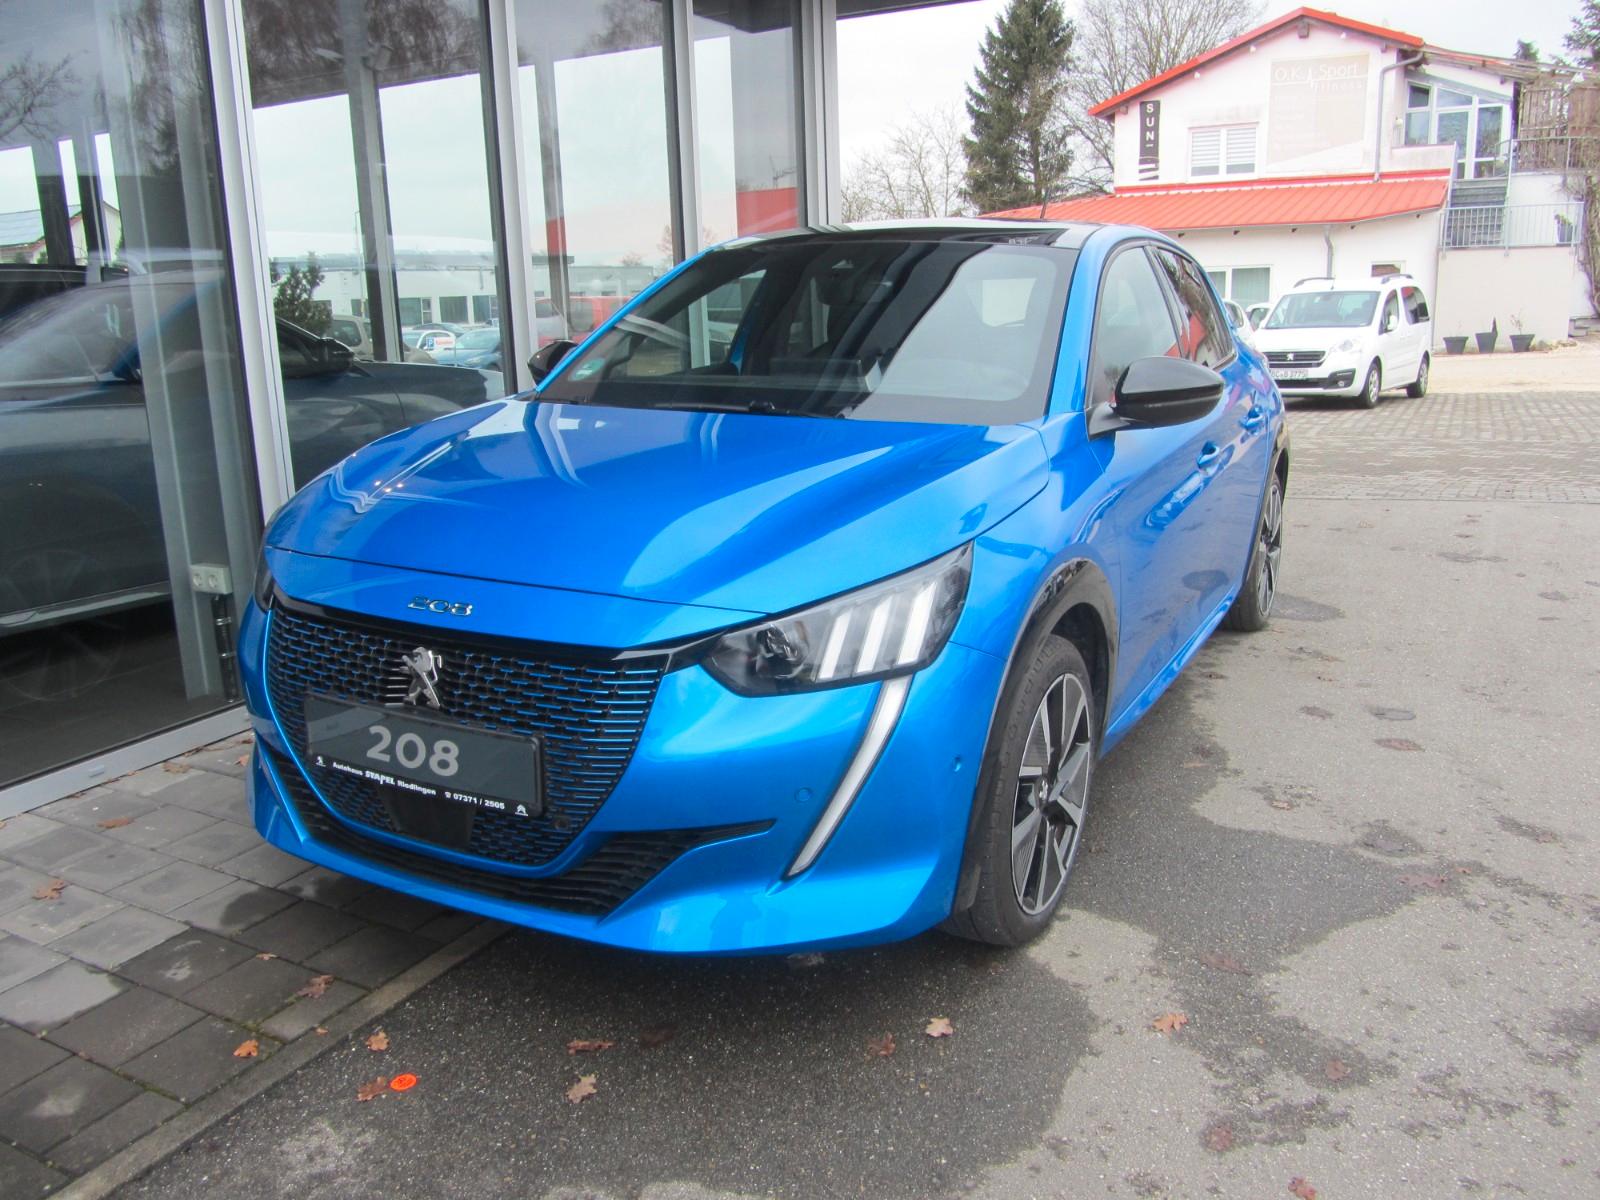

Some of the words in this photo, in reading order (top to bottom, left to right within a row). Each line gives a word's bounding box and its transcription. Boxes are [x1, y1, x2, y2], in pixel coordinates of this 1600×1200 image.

[1319, 63, 1357, 79] Sport
[407, 596, 473, 616] 208
[366, 725, 459, 777] 208
[333, 762, 363, 776] Autohaus
[365, 770, 396, 785] STAPEL
[397, 780, 436, 796] Riedlingen
[453, 793, 477, 804] 07371
